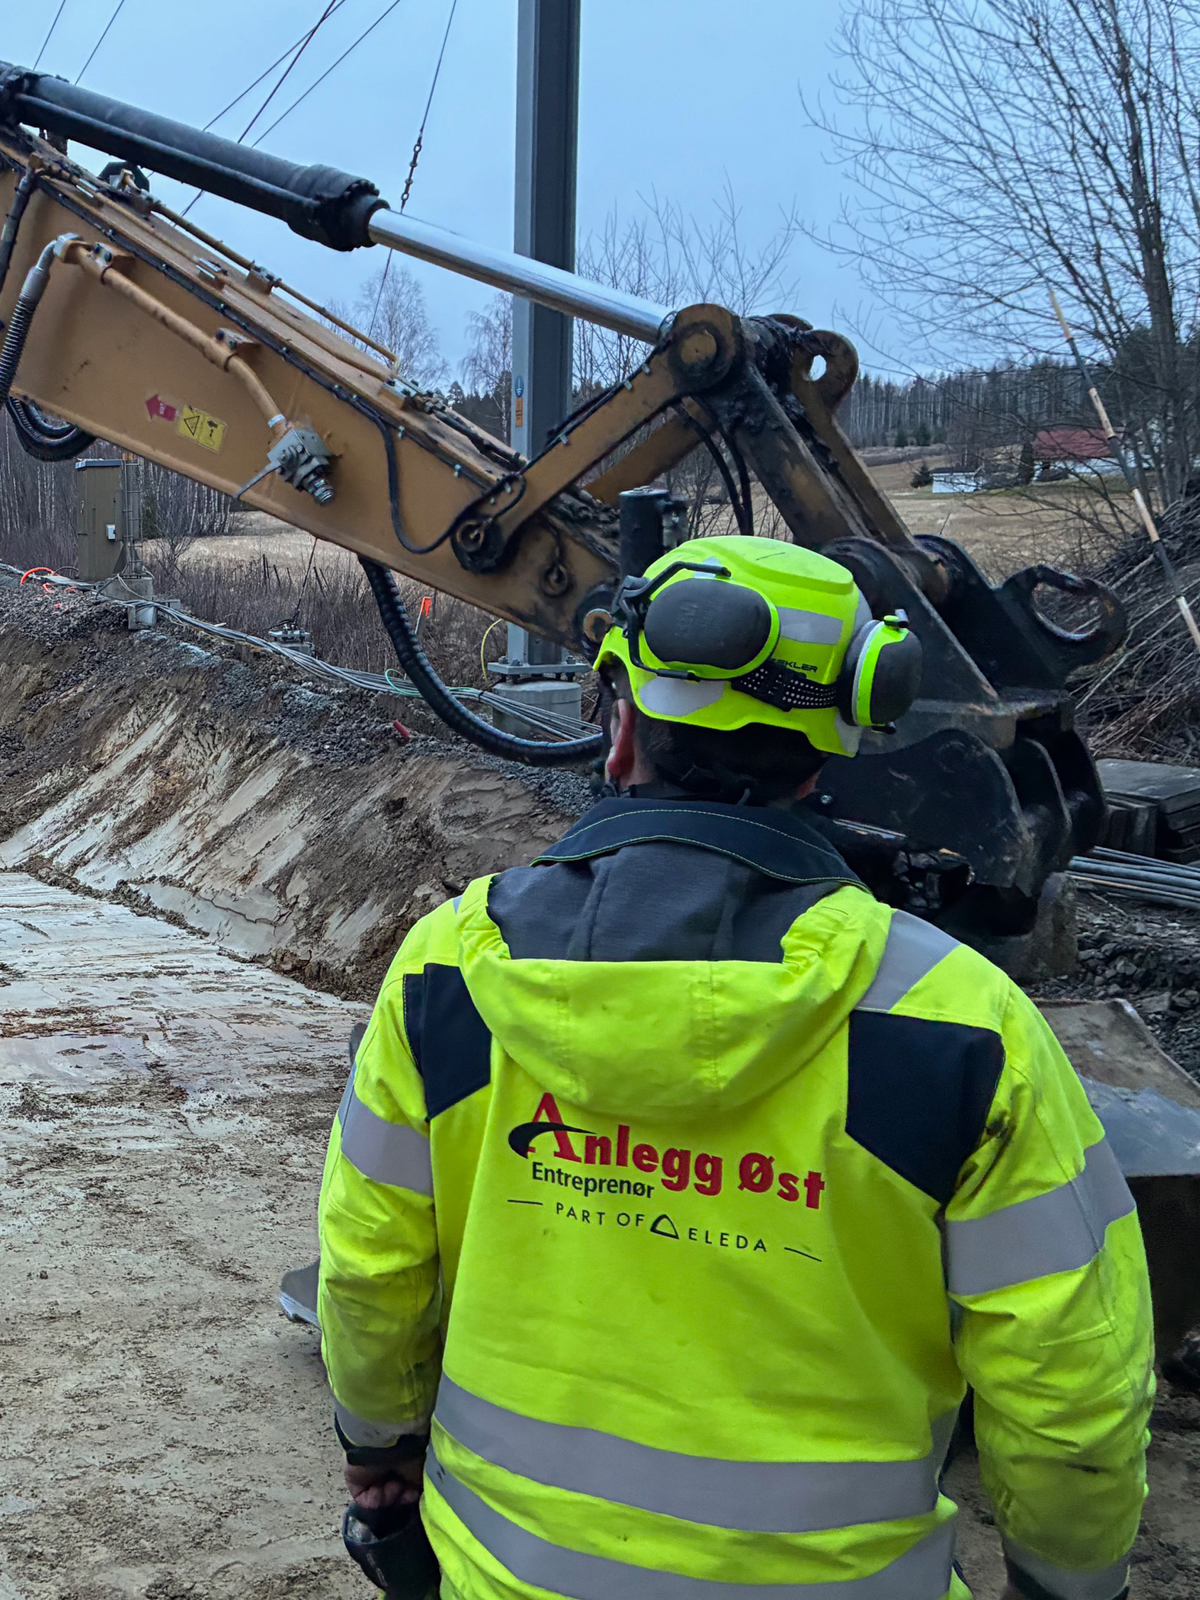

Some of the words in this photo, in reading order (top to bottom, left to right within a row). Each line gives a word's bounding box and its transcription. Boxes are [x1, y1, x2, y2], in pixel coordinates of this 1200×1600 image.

[527, 1091, 723, 1197] Anlegg
[738, 1152, 826, 1210] Øst
[532, 1161, 655, 1199] Entreprenør
[555, 1201, 606, 1226] PART
[616, 1212, 645, 1227] OF
[688, 1227, 768, 1253] ELEDA
